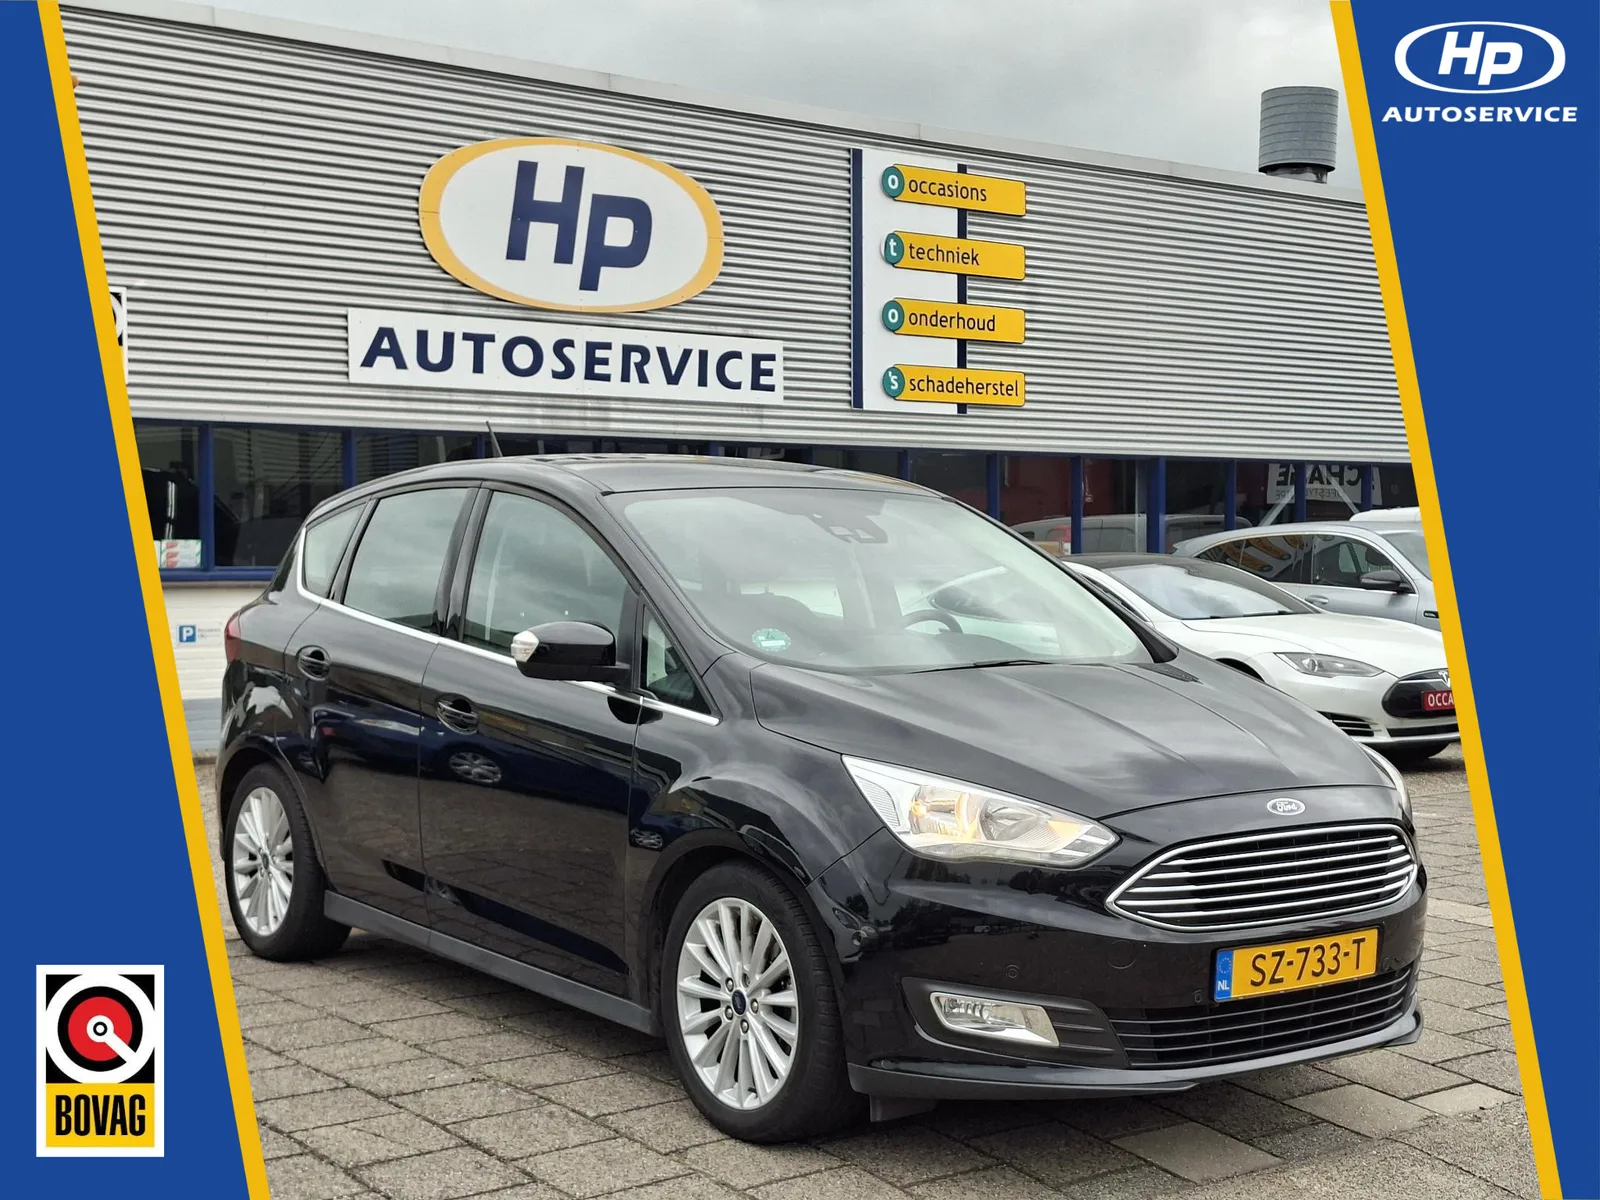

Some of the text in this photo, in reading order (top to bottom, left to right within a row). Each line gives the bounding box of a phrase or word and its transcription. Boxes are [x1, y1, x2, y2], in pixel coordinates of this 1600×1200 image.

[908, 179, 988, 202] occasions
[908, 243, 981, 266] techniek
[908, 310, 996, 332] onderhoud
[359, 326, 777, 392] AUTOSERVICE
[909, 375, 1019, 397] schadeherstel
[182, 626, 194, 642] P
[1276, 801, 1298, 812] Ford
[1250, 937, 1366, 987] SZ-733-T
[1217, 979, 1230, 991] NL
